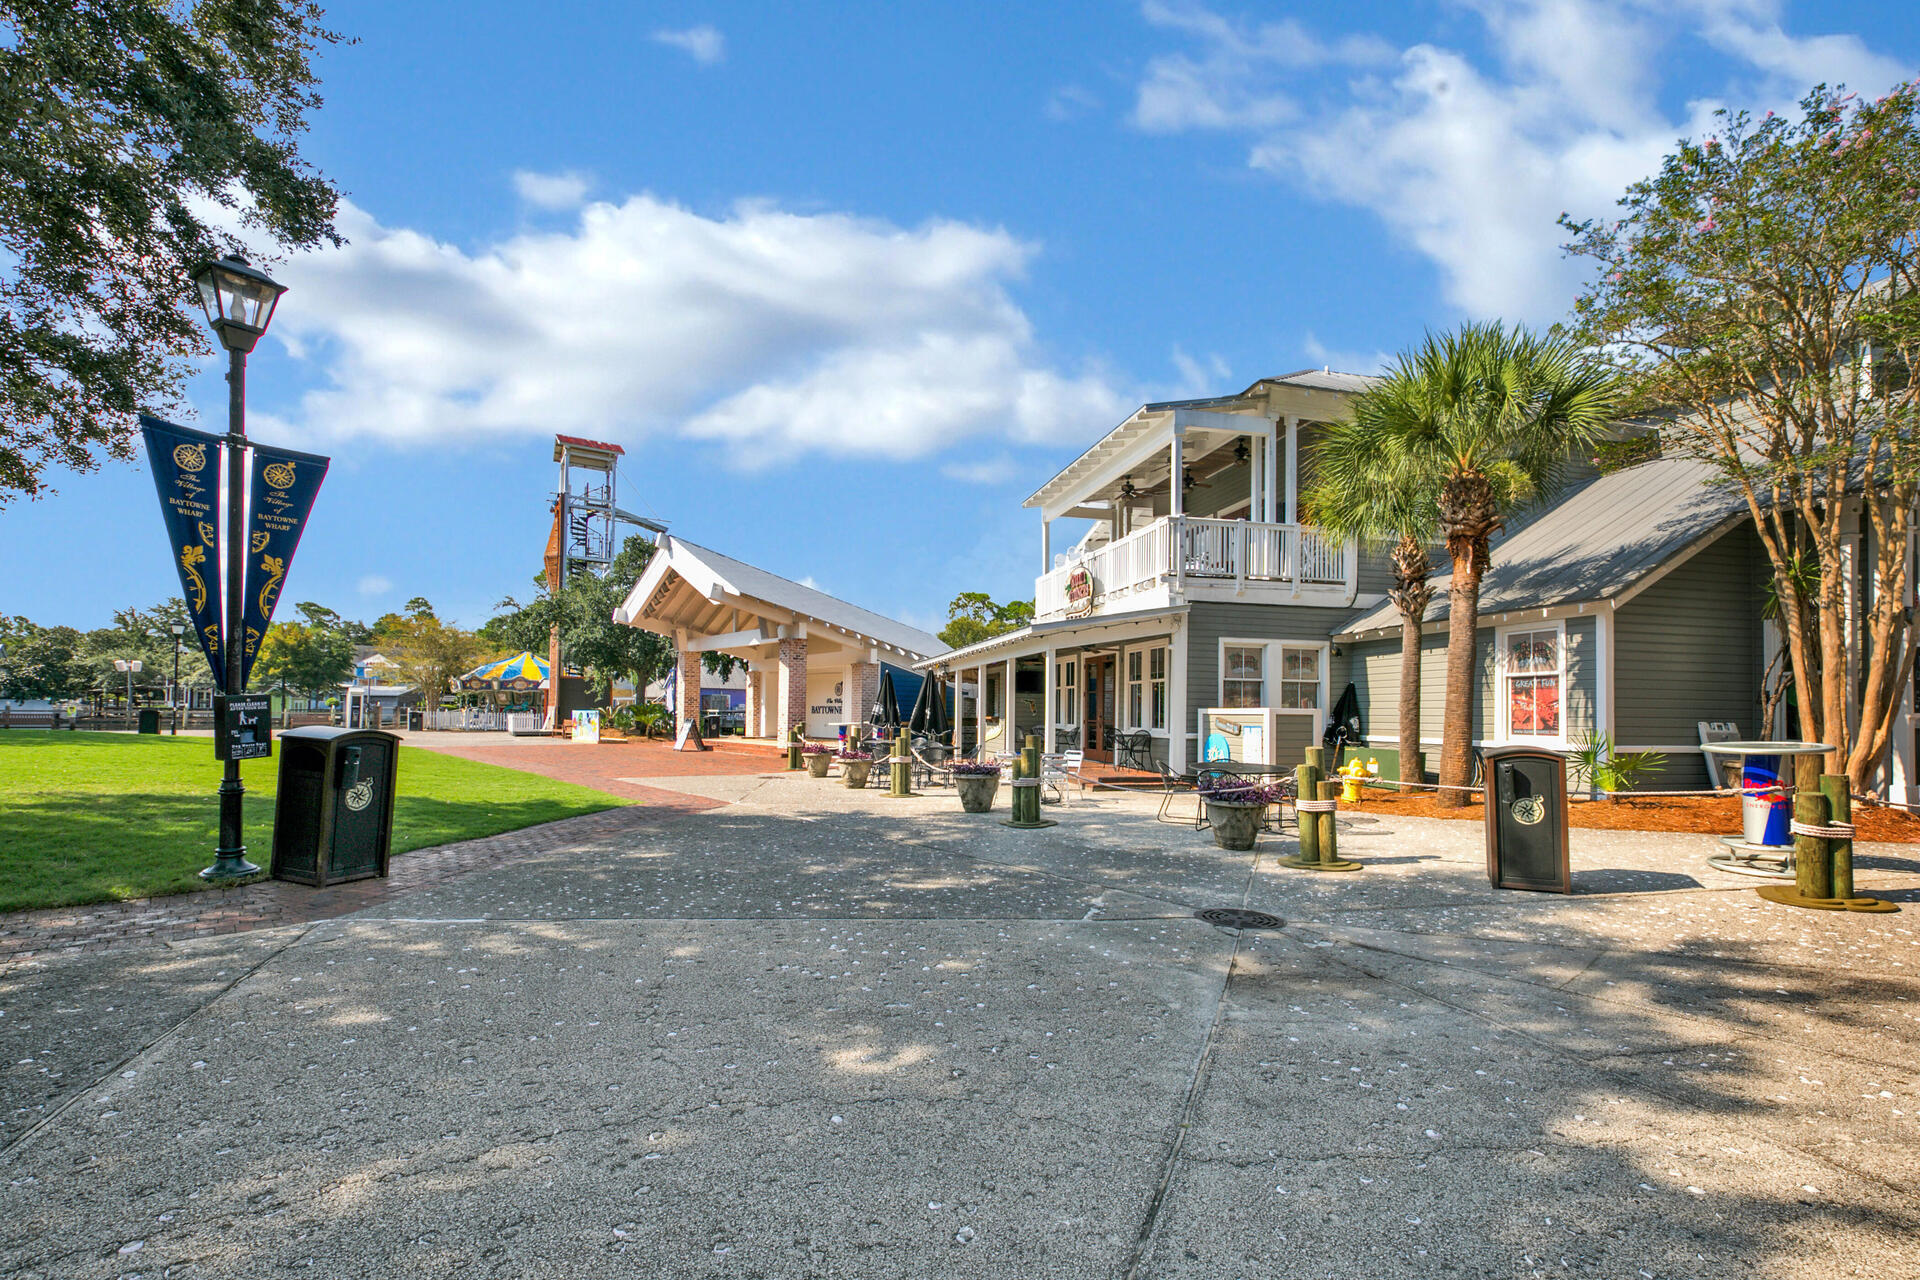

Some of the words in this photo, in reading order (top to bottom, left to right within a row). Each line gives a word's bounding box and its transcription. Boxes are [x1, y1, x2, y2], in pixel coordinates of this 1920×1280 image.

[180, 473, 201, 482] The
[174, 479, 206, 491] Village
[185, 491, 196, 499] of
[269, 490, 290, 499] The
[169, 497, 211, 511] BAYTOWNE
[263, 496, 295, 507] Village
[177, 507, 204, 518] WHARF
[257, 513, 298, 524] BAYTOWNE
[264, 522, 291, 532] WHARF
[1541, 679, 1556, 688] FUN
